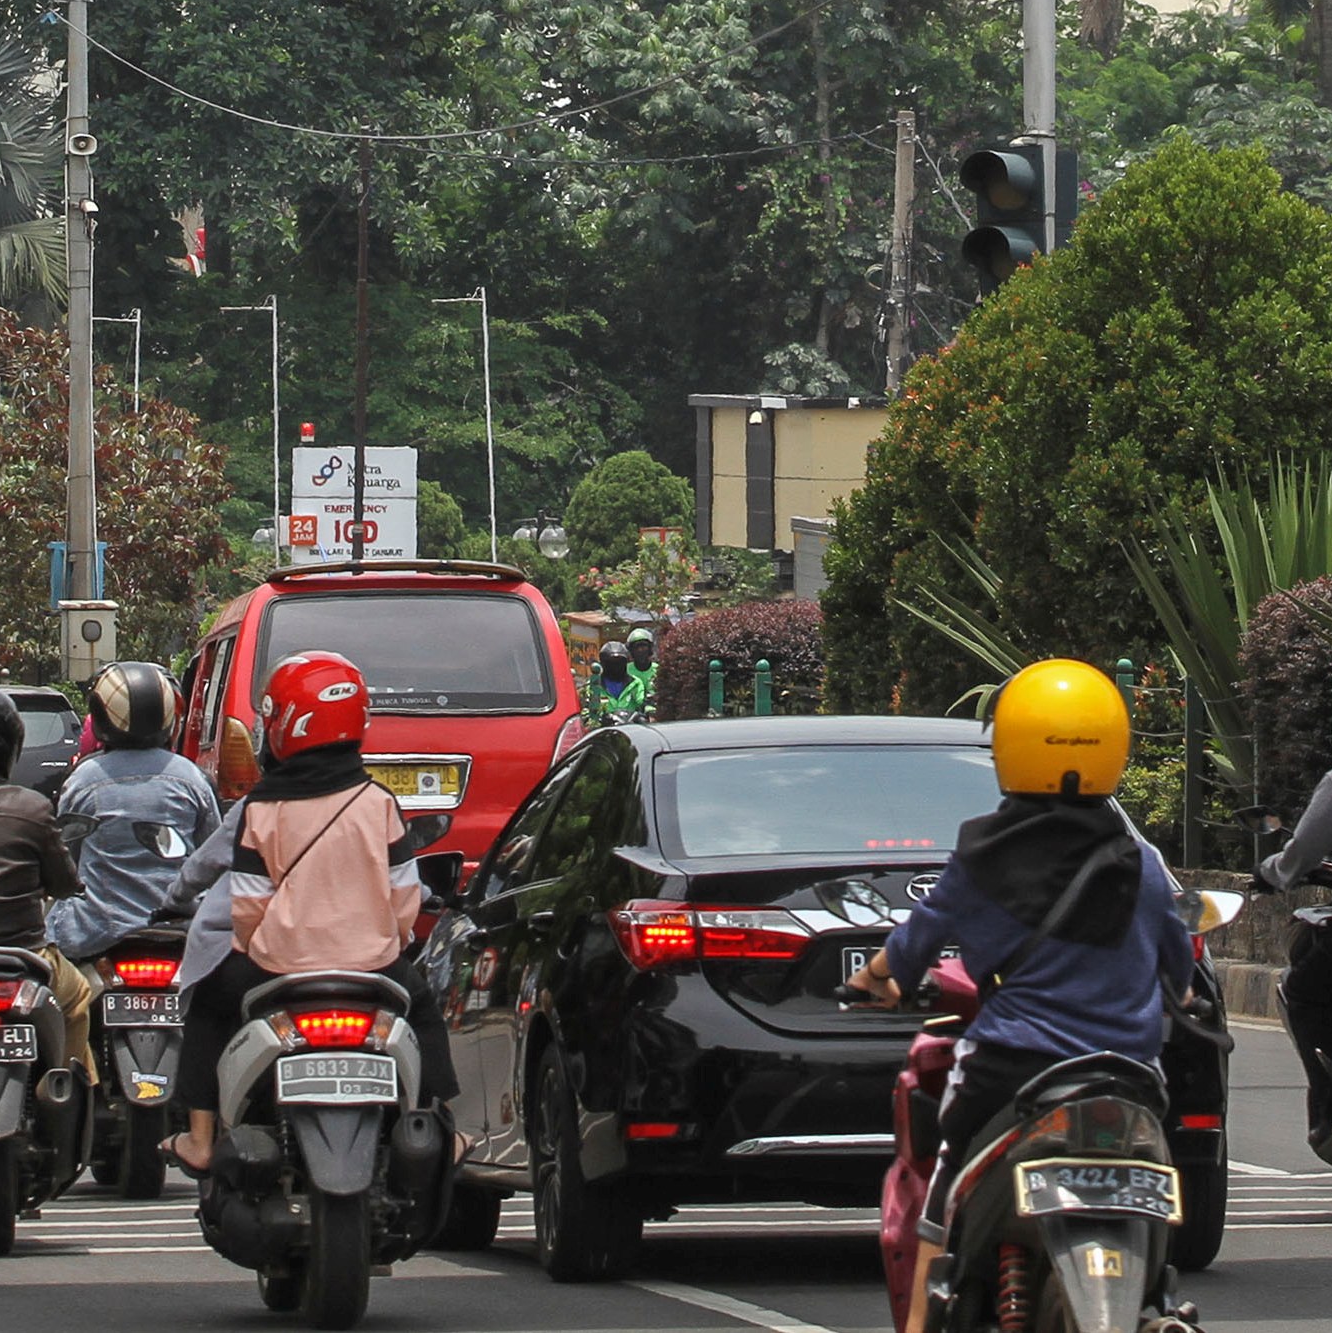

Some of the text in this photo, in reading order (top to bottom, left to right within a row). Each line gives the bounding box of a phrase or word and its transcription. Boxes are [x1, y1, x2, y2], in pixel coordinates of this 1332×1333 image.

[293, 520, 313, 533] 24
[292, 533, 314, 542] JAM
[107, 996, 116, 1010] B
[123, 996, 158, 1010] 3867
[3, 1028, 31, 1043] ELI
[284, 1059, 389, 1079] B 6833 ZJX
[1058, 1168, 1119, 1187] 3424
[1129, 1168, 1168, 1195] EFZ
